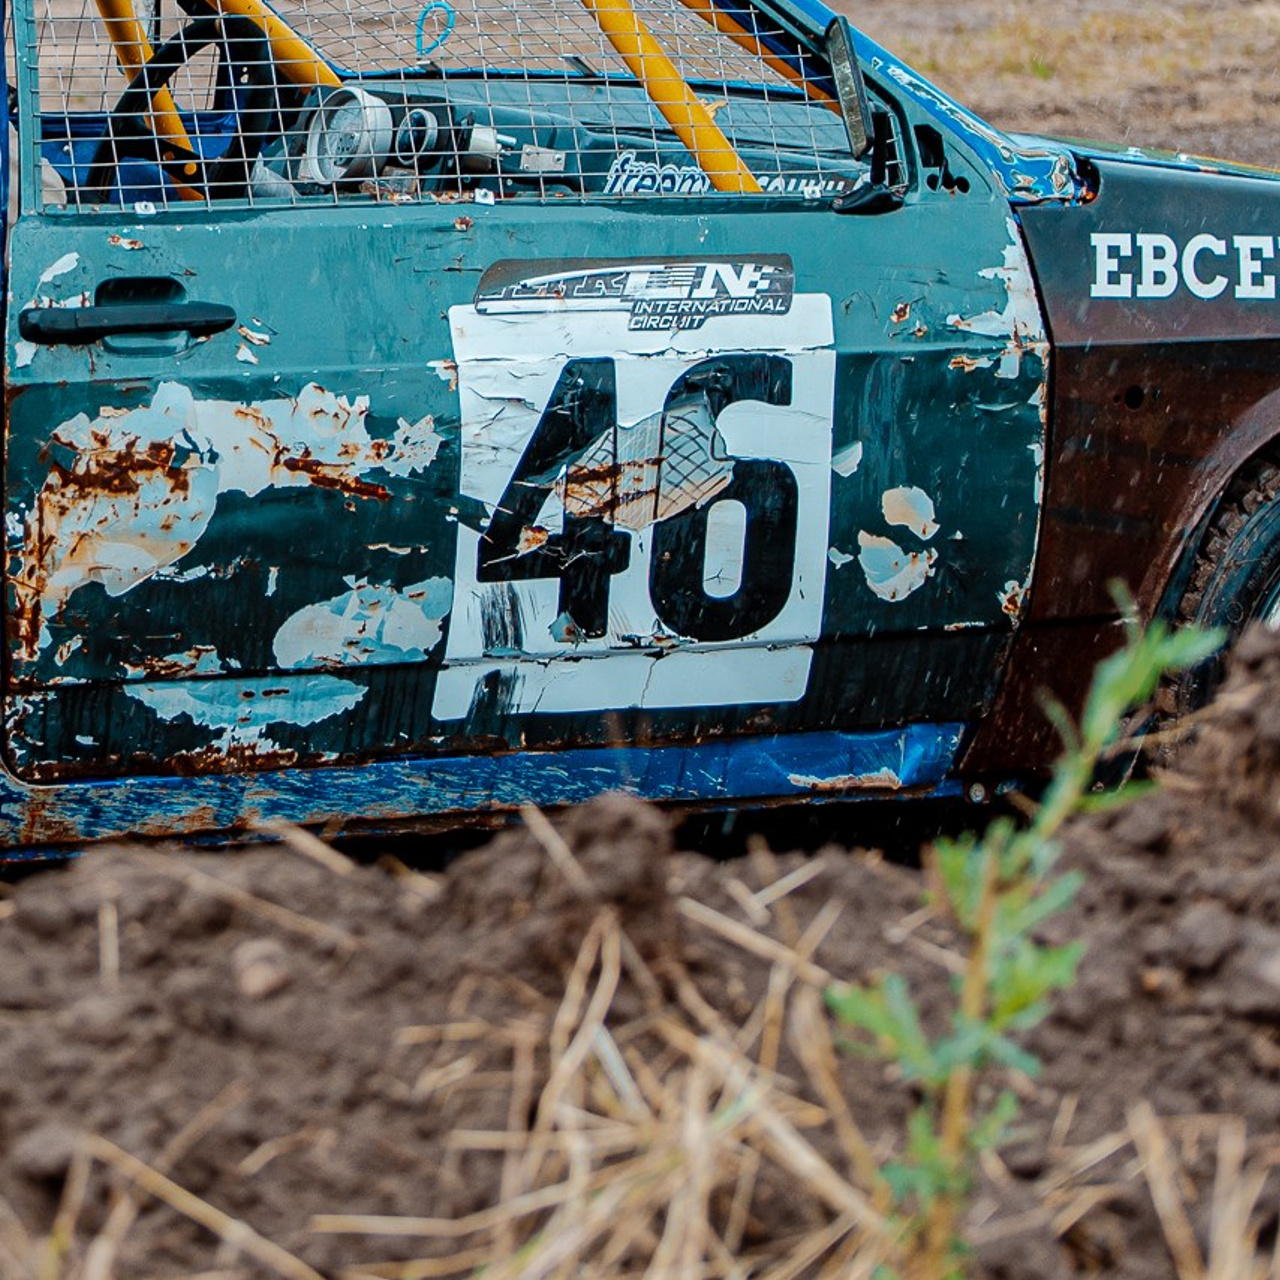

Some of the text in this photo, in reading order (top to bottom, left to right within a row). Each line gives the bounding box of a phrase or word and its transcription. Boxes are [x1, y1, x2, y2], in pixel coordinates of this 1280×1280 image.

[634, 299, 786, 314] INTERNATIONAL
[630, 315, 705, 329] CIRCUIT
[477, 353, 799, 642] 46
